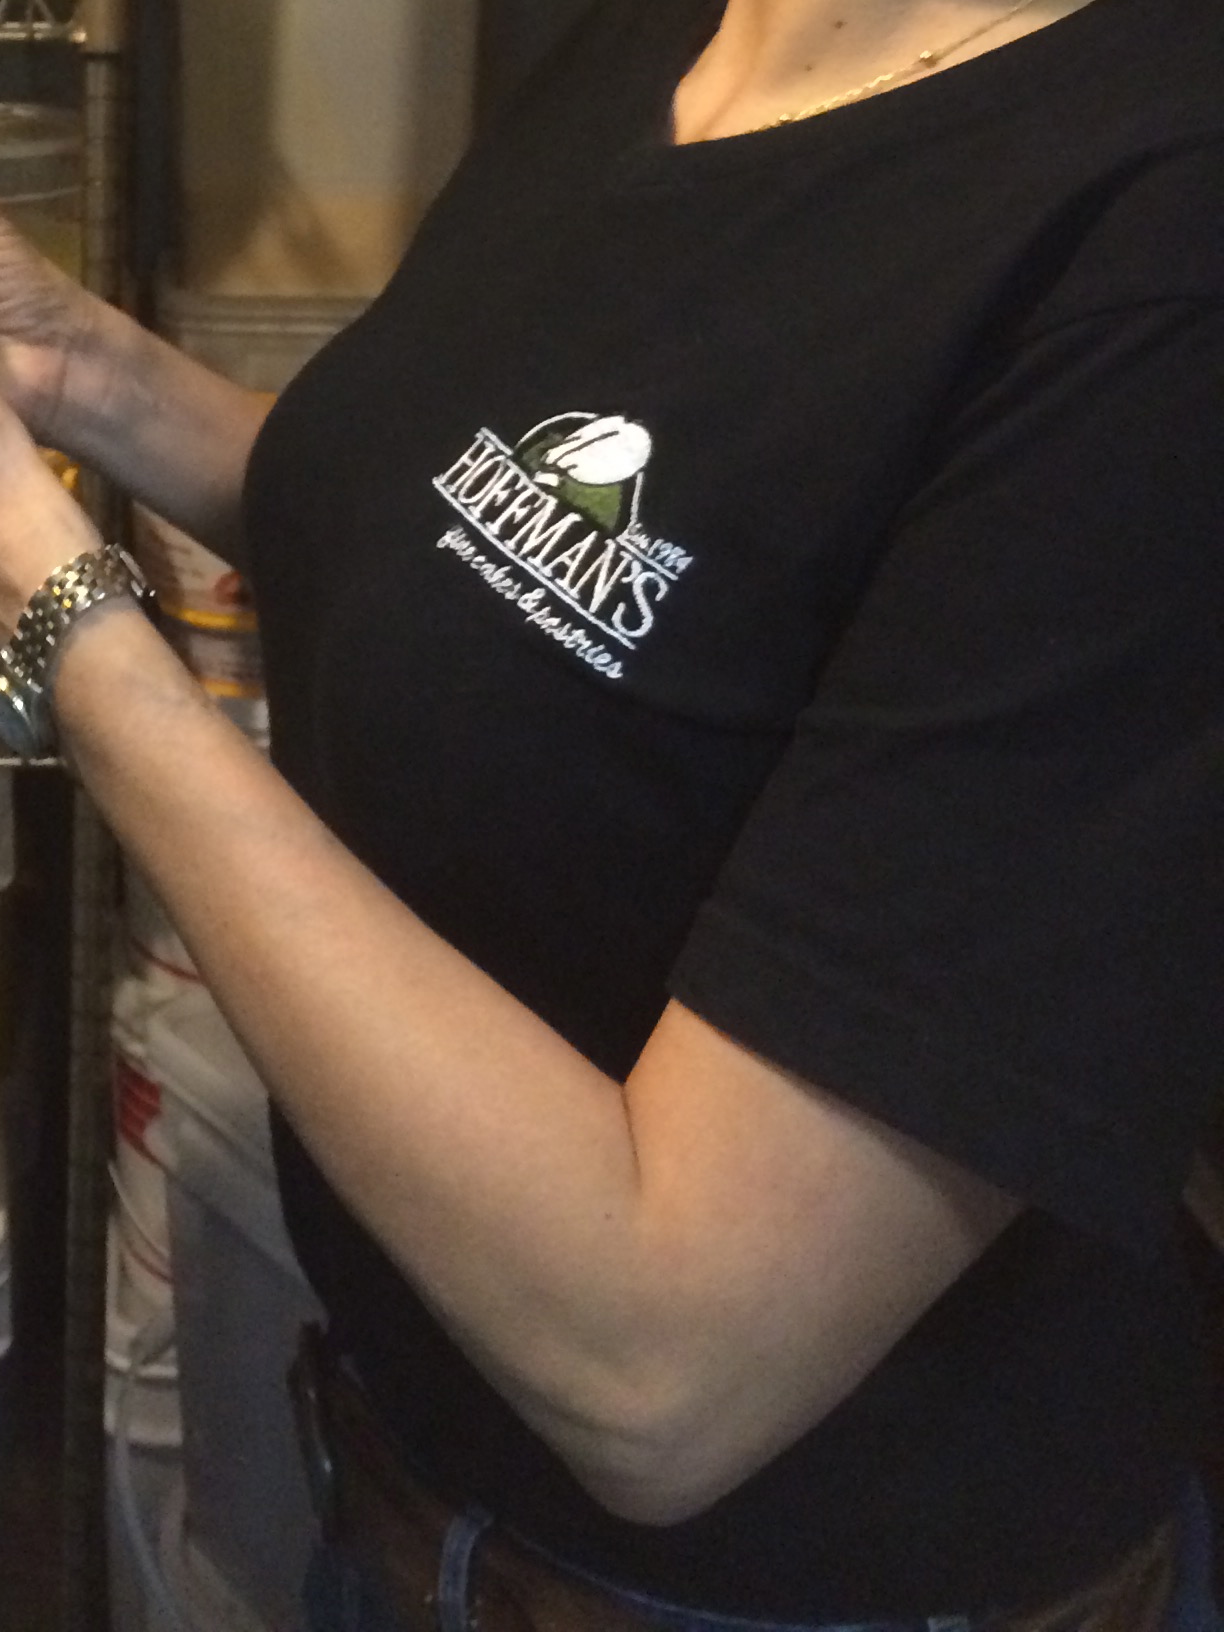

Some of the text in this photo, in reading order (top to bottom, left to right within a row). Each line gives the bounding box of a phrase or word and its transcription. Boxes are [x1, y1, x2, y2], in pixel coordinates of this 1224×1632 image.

[433, 427, 669, 638] HOFFMAN'S
[517, 587, 546, 614] &
[526, 606, 623, 679] pastries
